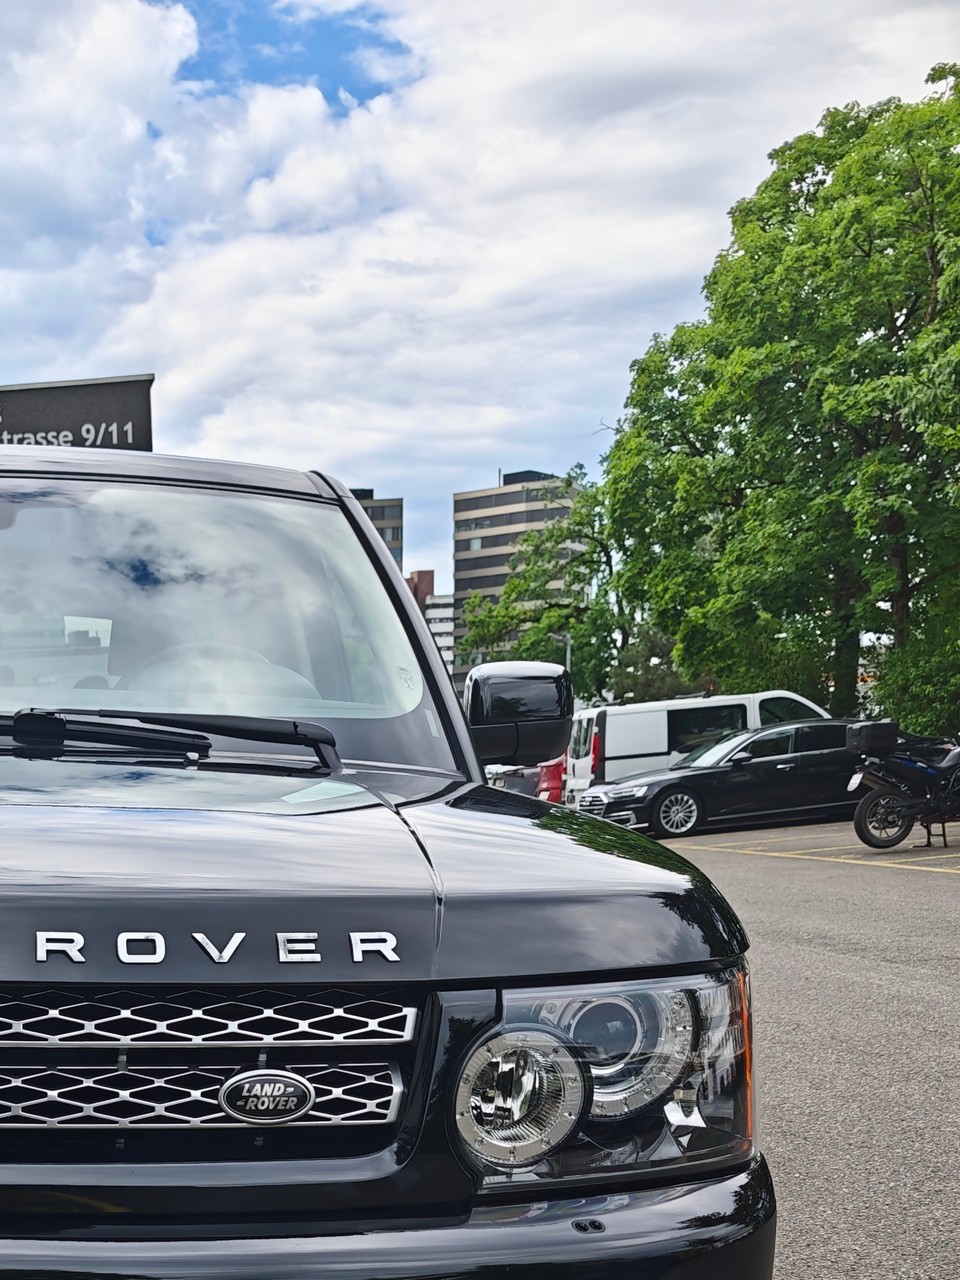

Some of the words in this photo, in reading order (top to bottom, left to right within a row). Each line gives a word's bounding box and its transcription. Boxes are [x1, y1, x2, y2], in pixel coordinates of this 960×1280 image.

[80, 421, 133, 446] 9/11
[35, 931, 401, 963] ROVER
[242, 1083, 285, 1096] LAND
[245, 1097, 298, 1110] ROVER
